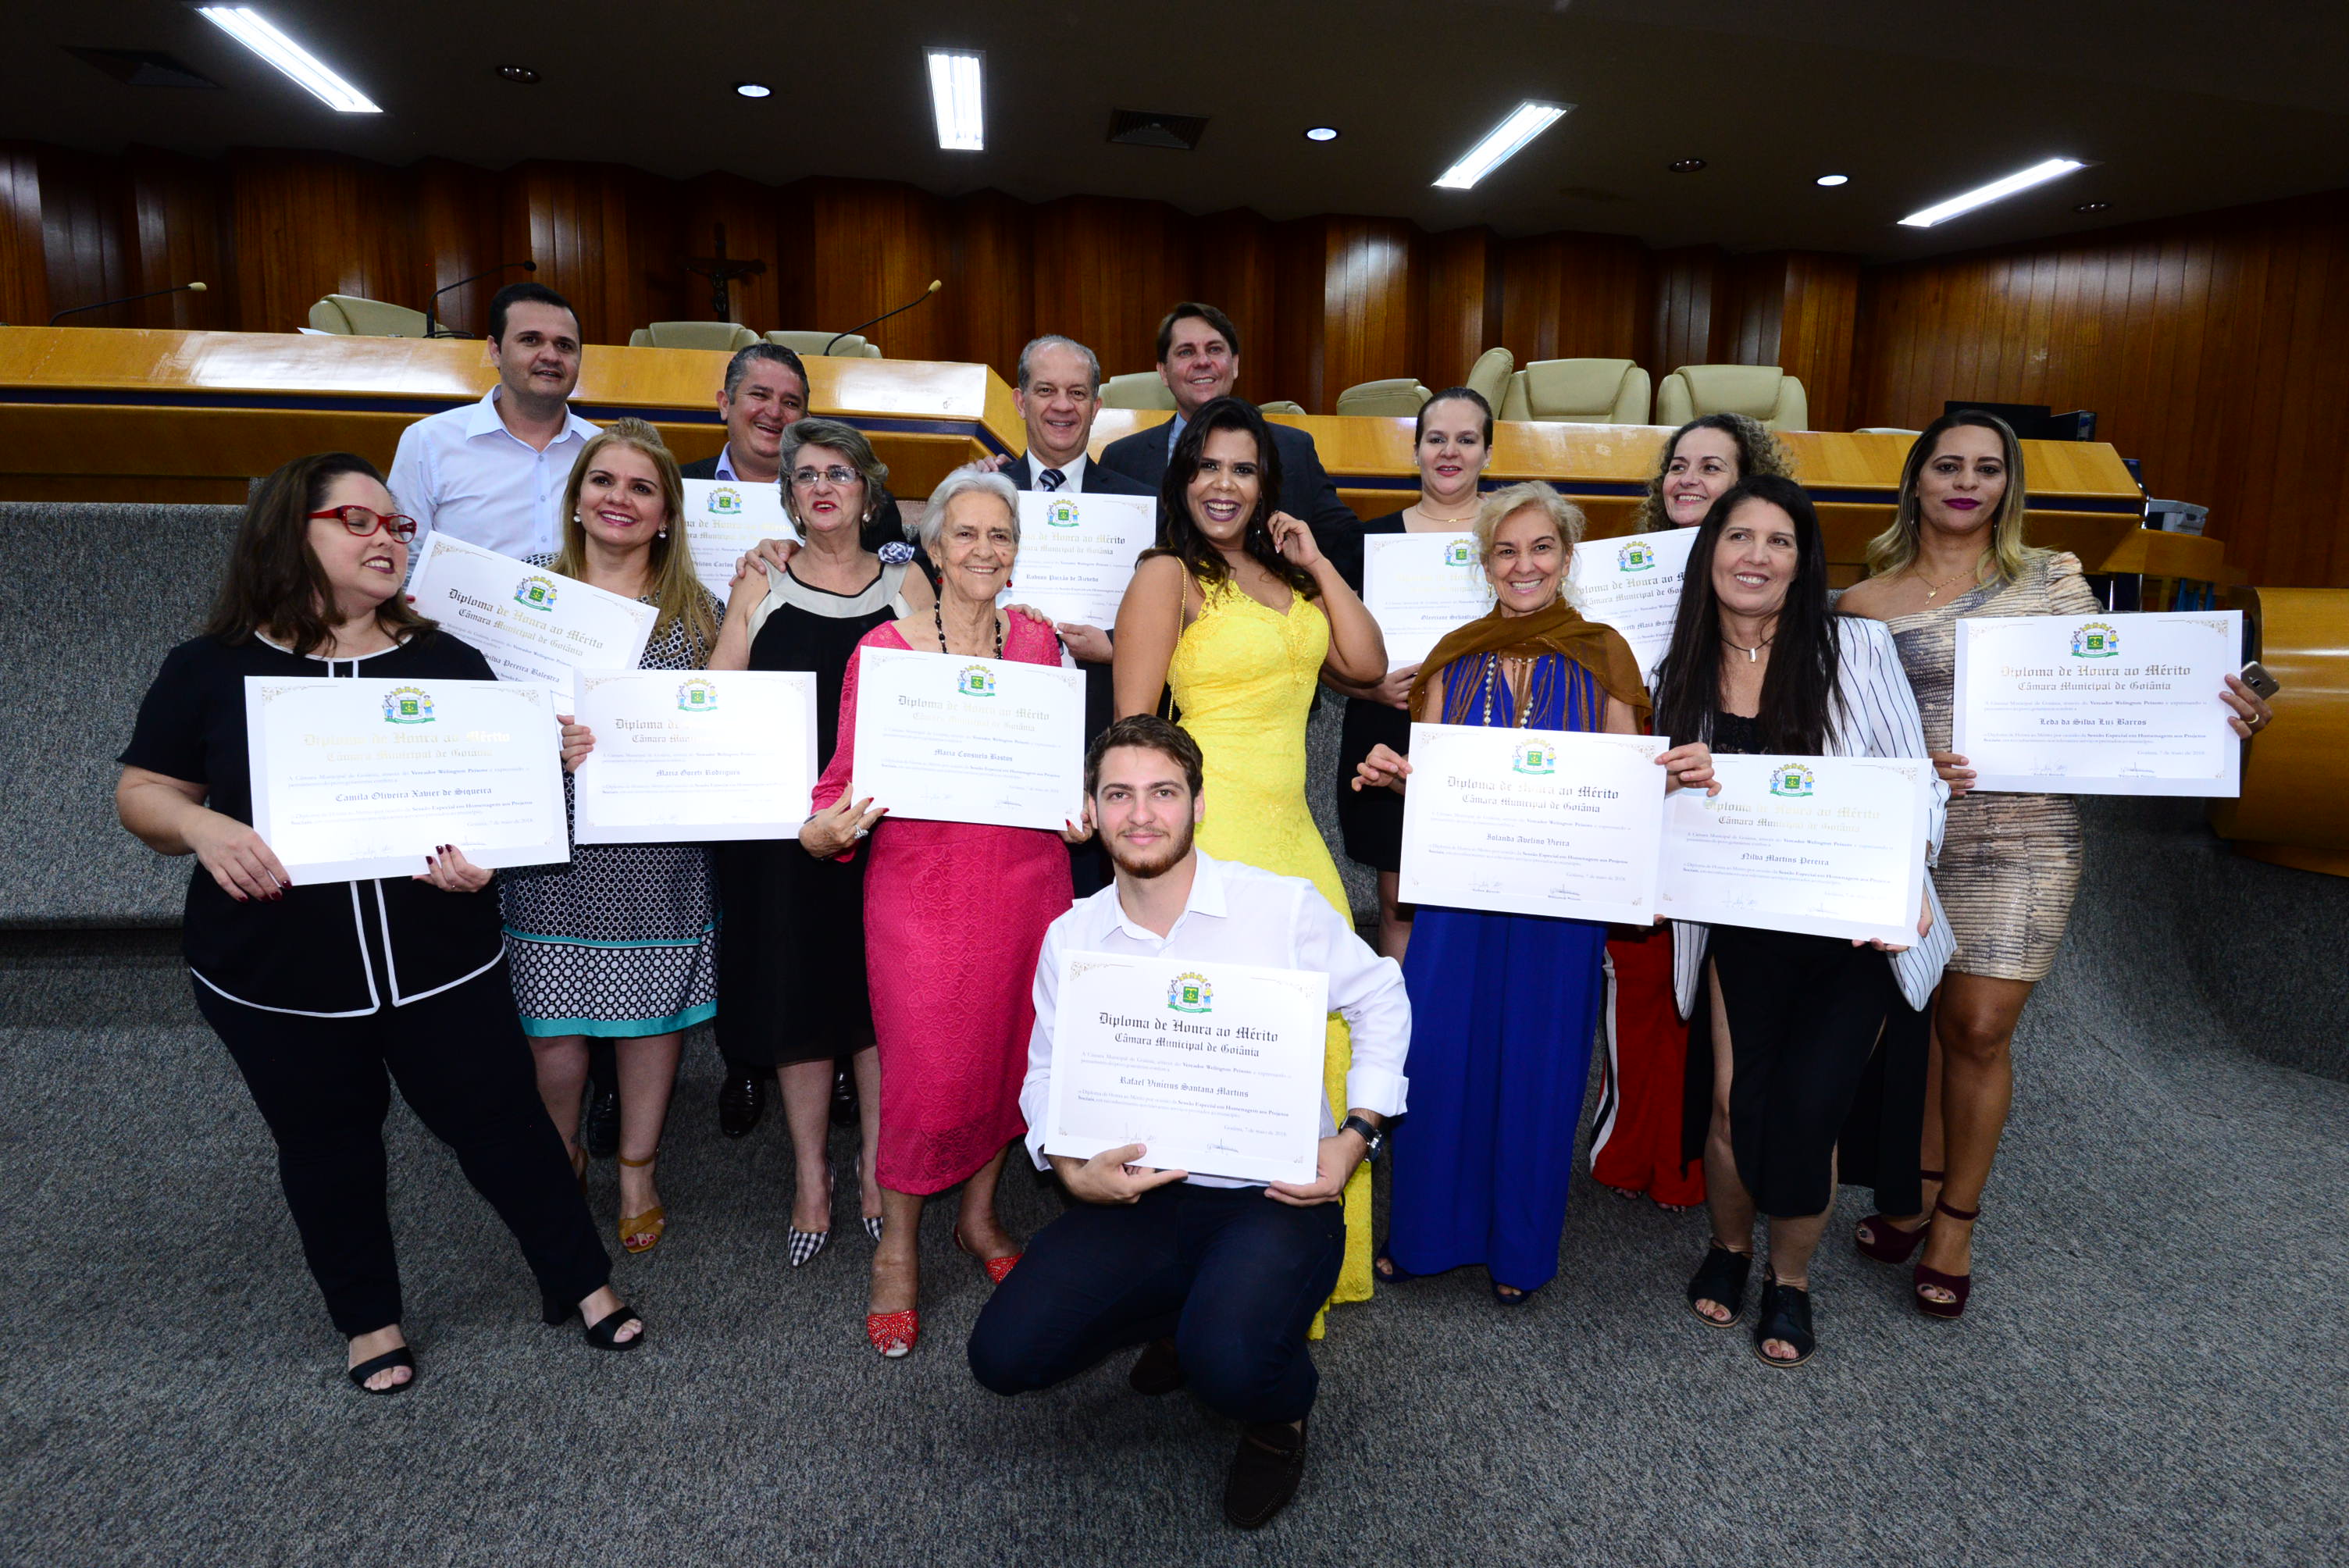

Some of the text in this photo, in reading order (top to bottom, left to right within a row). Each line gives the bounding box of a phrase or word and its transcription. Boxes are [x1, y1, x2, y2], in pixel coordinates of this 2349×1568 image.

[1096, 534, 1125, 544] Mérito
[1612, 581, 1623, 590] de
[1626, 578, 1658, 588] Honra
[1662, 576, 1673, 584] ao
[1616, 591, 1654, 602] Municipal
[449, 588, 603, 649] Diploma de Honra ao Mérito
[458, 608, 490, 625] Câmara
[494, 618, 536, 642] Municipal
[538, 633, 548, 644] de
[550, 640, 583, 657] Goiânia
[503, 658, 529, 675] Pereira
[531, 668, 560, 683] Balestra
[2001, 664, 2190, 678] Diploma de Honra ao Mérito
[2018, 681, 2171, 692] Câmara Municipal de Goiânia
[898, 695, 943, 711] Diploma
[946, 700, 959, 711] de
[1015, 707, 1050, 721] Mérito
[615, 718, 663, 731] Diploma
[393, 732, 438, 744] Honra
[632, 734, 665, 743] Câmara
[934, 749, 955, 757] Maria
[990, 752, 1013, 762] Bastos
[335, 792, 369, 803] Camila
[371, 790, 409, 800] Oliveira
[412, 789, 440, 798] Xavier
[454, 786, 493, 797] Siqueira
[1448, 776, 1495, 794] Diploma
[1499, 781, 1513, 791] de
[1559, 787, 1573, 796] ao
[1578, 786, 1619, 799] Mérito
[1462, 794, 1600, 813] Câmara Municipal de Goiânia
[1837, 807, 1880, 819] Mérito
[1719, 816, 1754, 825] Câmara
[1517, 835, 1545, 846] Avelino
[1741, 852, 1829, 867] Nilva Martins Pereira
[1099, 1012, 1278, 1042] Diploma de Honra ao Mérito
[1114, 1033, 1260, 1057] Câmara Municipal de Goiânia
[1119, 1076, 1249, 1098] Rafael Vinicius Santana Martins
